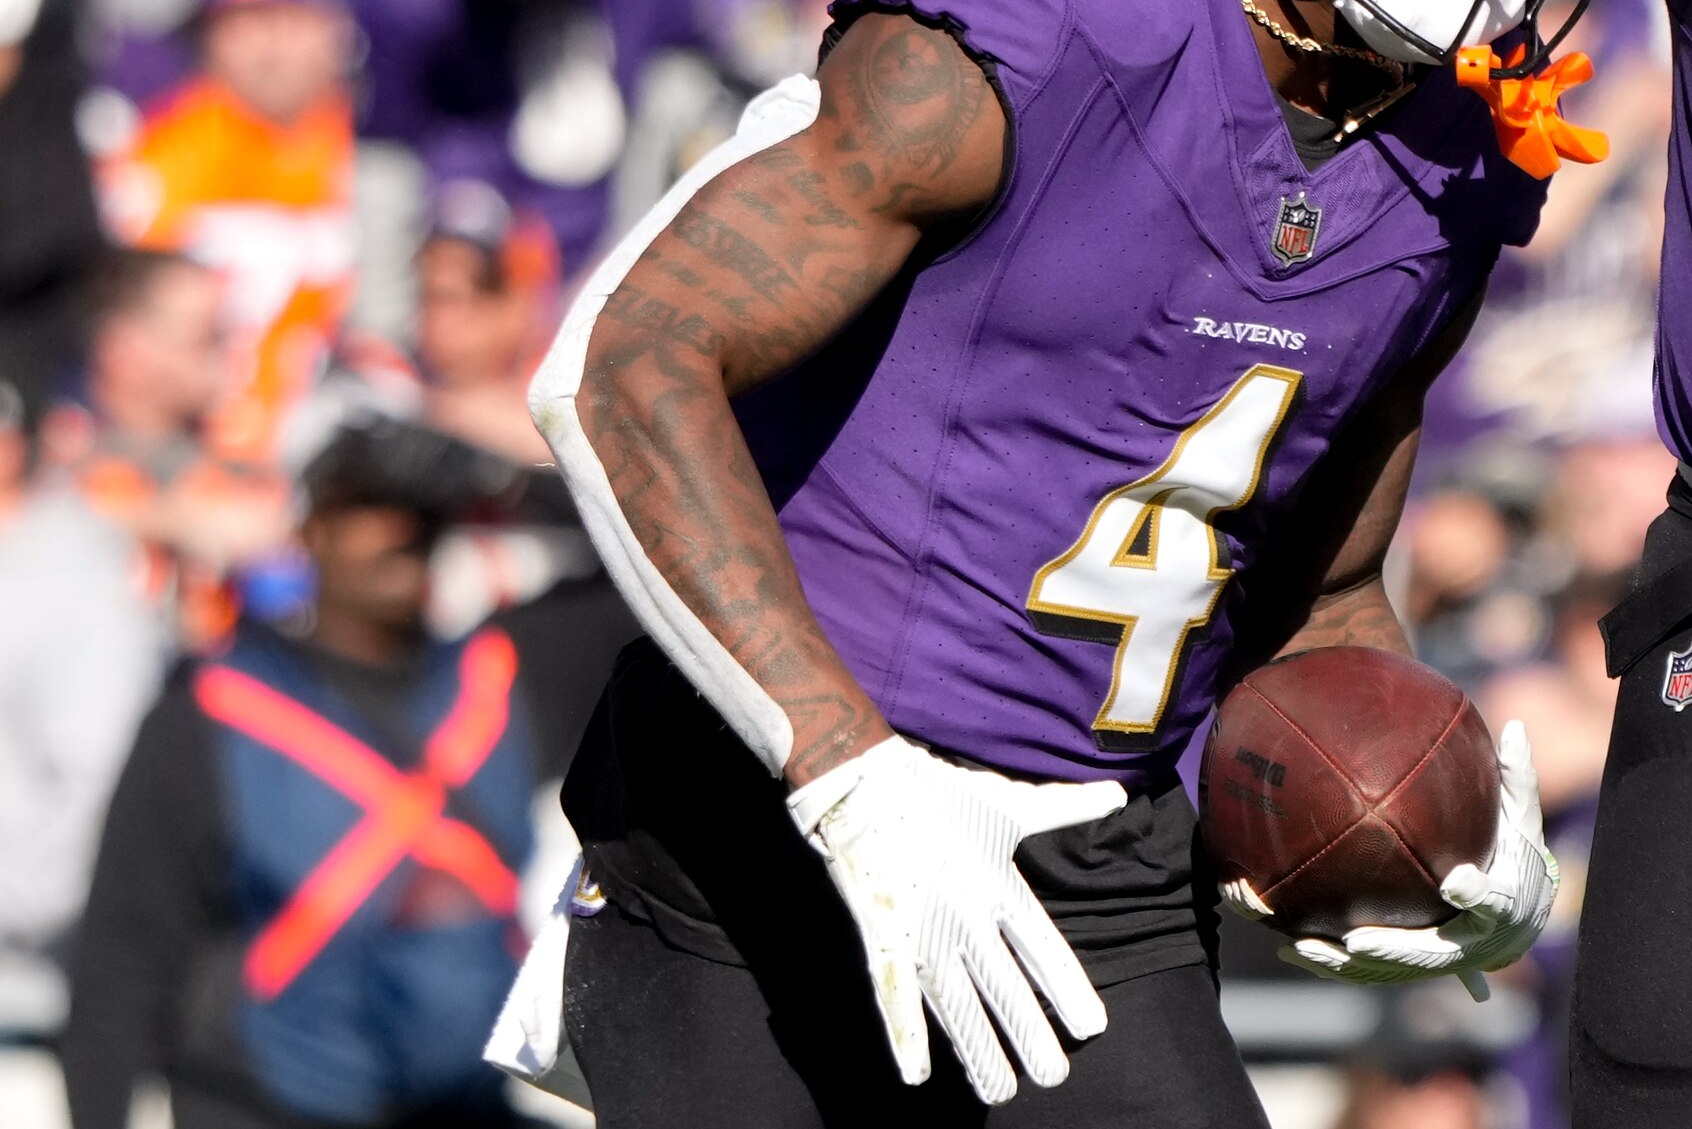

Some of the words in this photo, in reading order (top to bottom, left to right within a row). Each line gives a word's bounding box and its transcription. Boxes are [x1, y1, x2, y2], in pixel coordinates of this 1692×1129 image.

[1279, 224, 1310, 255] NFL
[1193, 317, 1307, 350] RAVENS
[1025, 362, 1306, 752] 4
